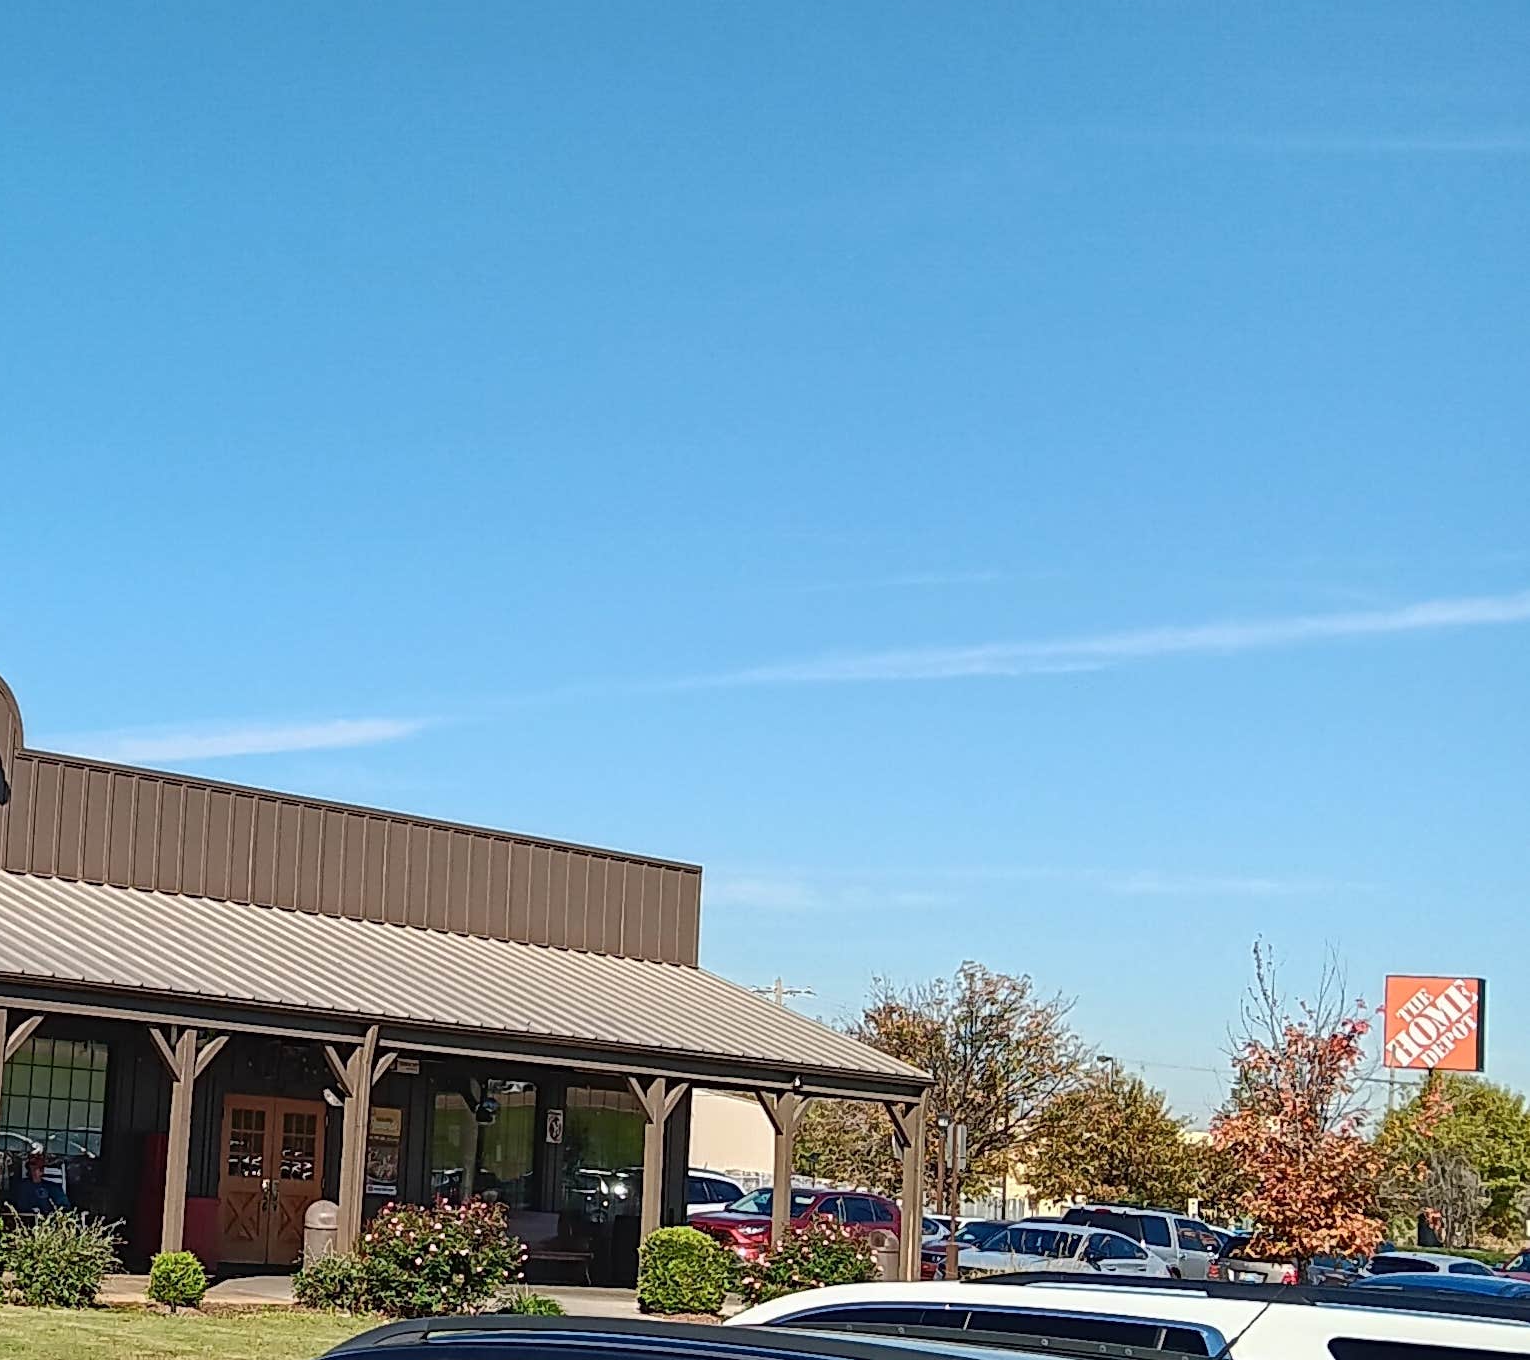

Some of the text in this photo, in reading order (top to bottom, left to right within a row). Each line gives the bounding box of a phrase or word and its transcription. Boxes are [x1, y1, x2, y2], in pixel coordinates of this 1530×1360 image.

[1385, 979, 1478, 1067] HOME
[1395, 987, 1435, 1023] THE
[1419, 1014, 1477, 1068] DEPOT
